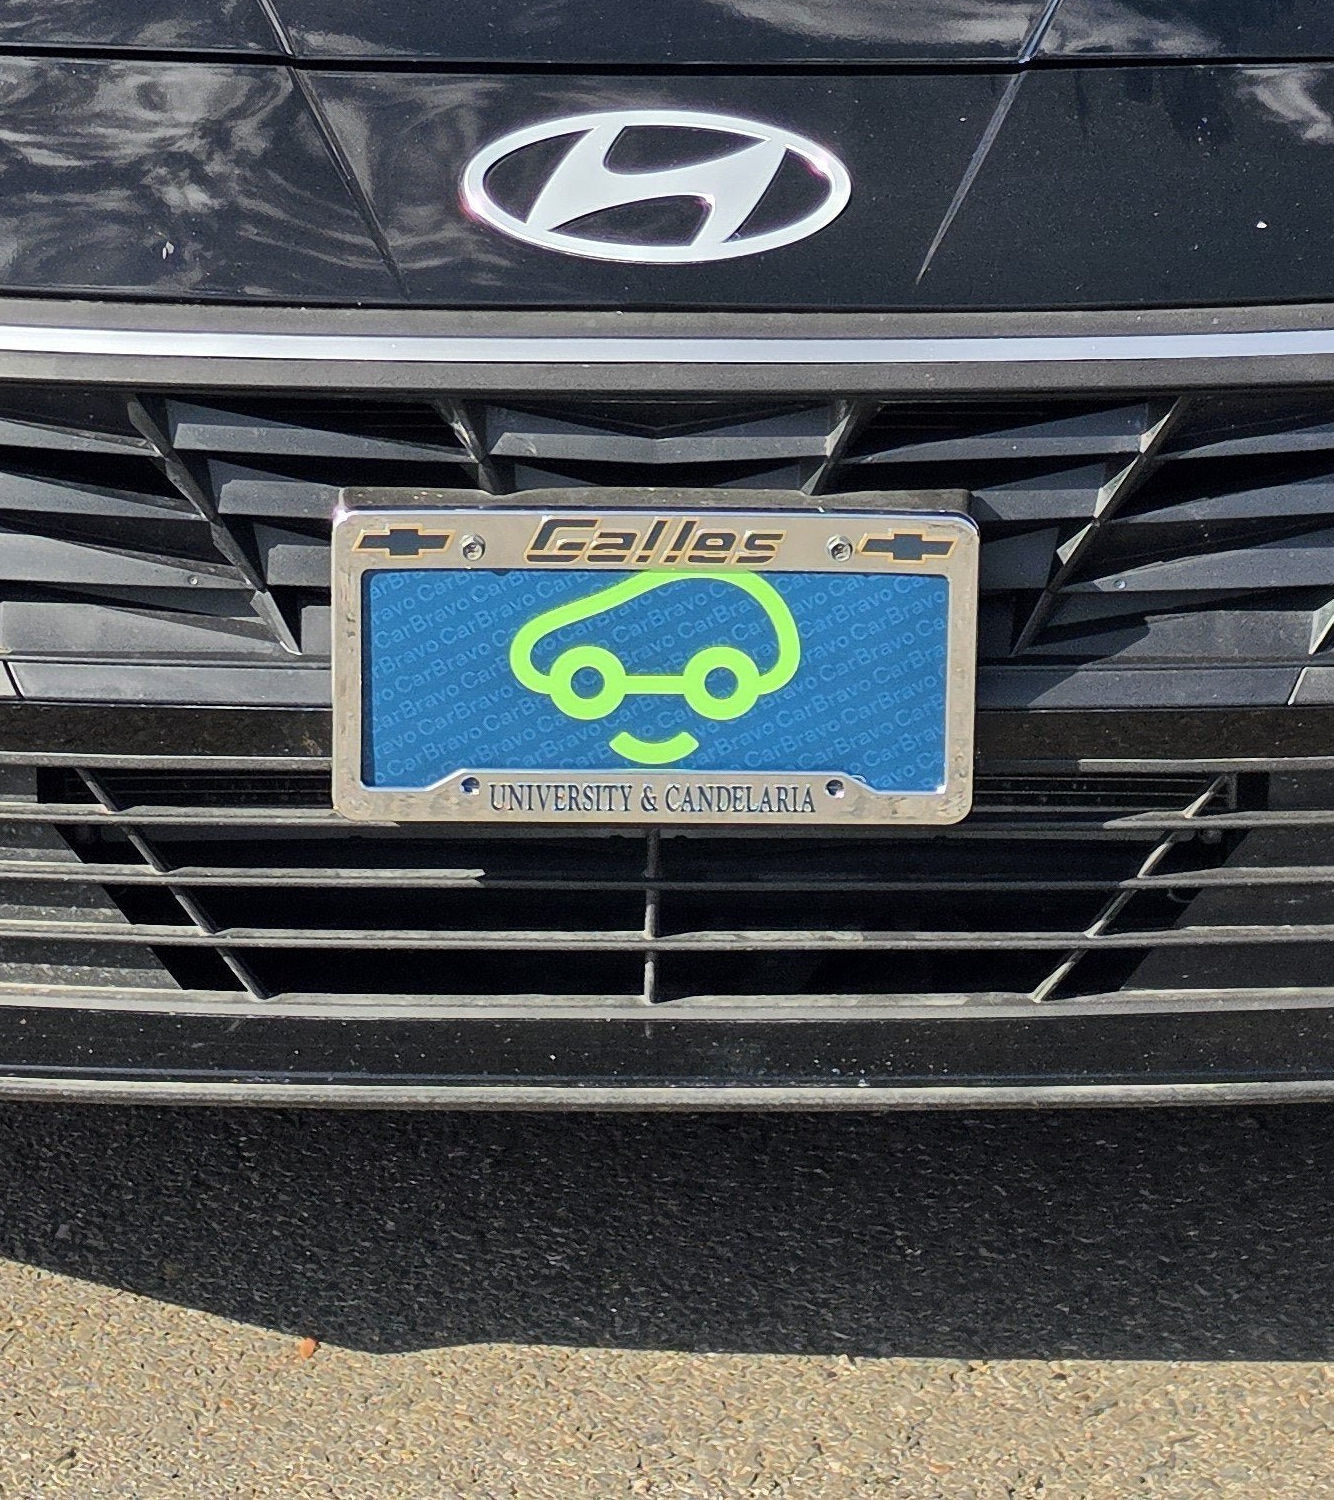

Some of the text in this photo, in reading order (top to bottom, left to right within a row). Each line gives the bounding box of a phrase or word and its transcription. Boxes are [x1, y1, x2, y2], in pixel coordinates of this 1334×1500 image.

[524, 516, 787, 564] Galles
[489, 784, 817, 813] UNIVERSITY & CANDELARIA
